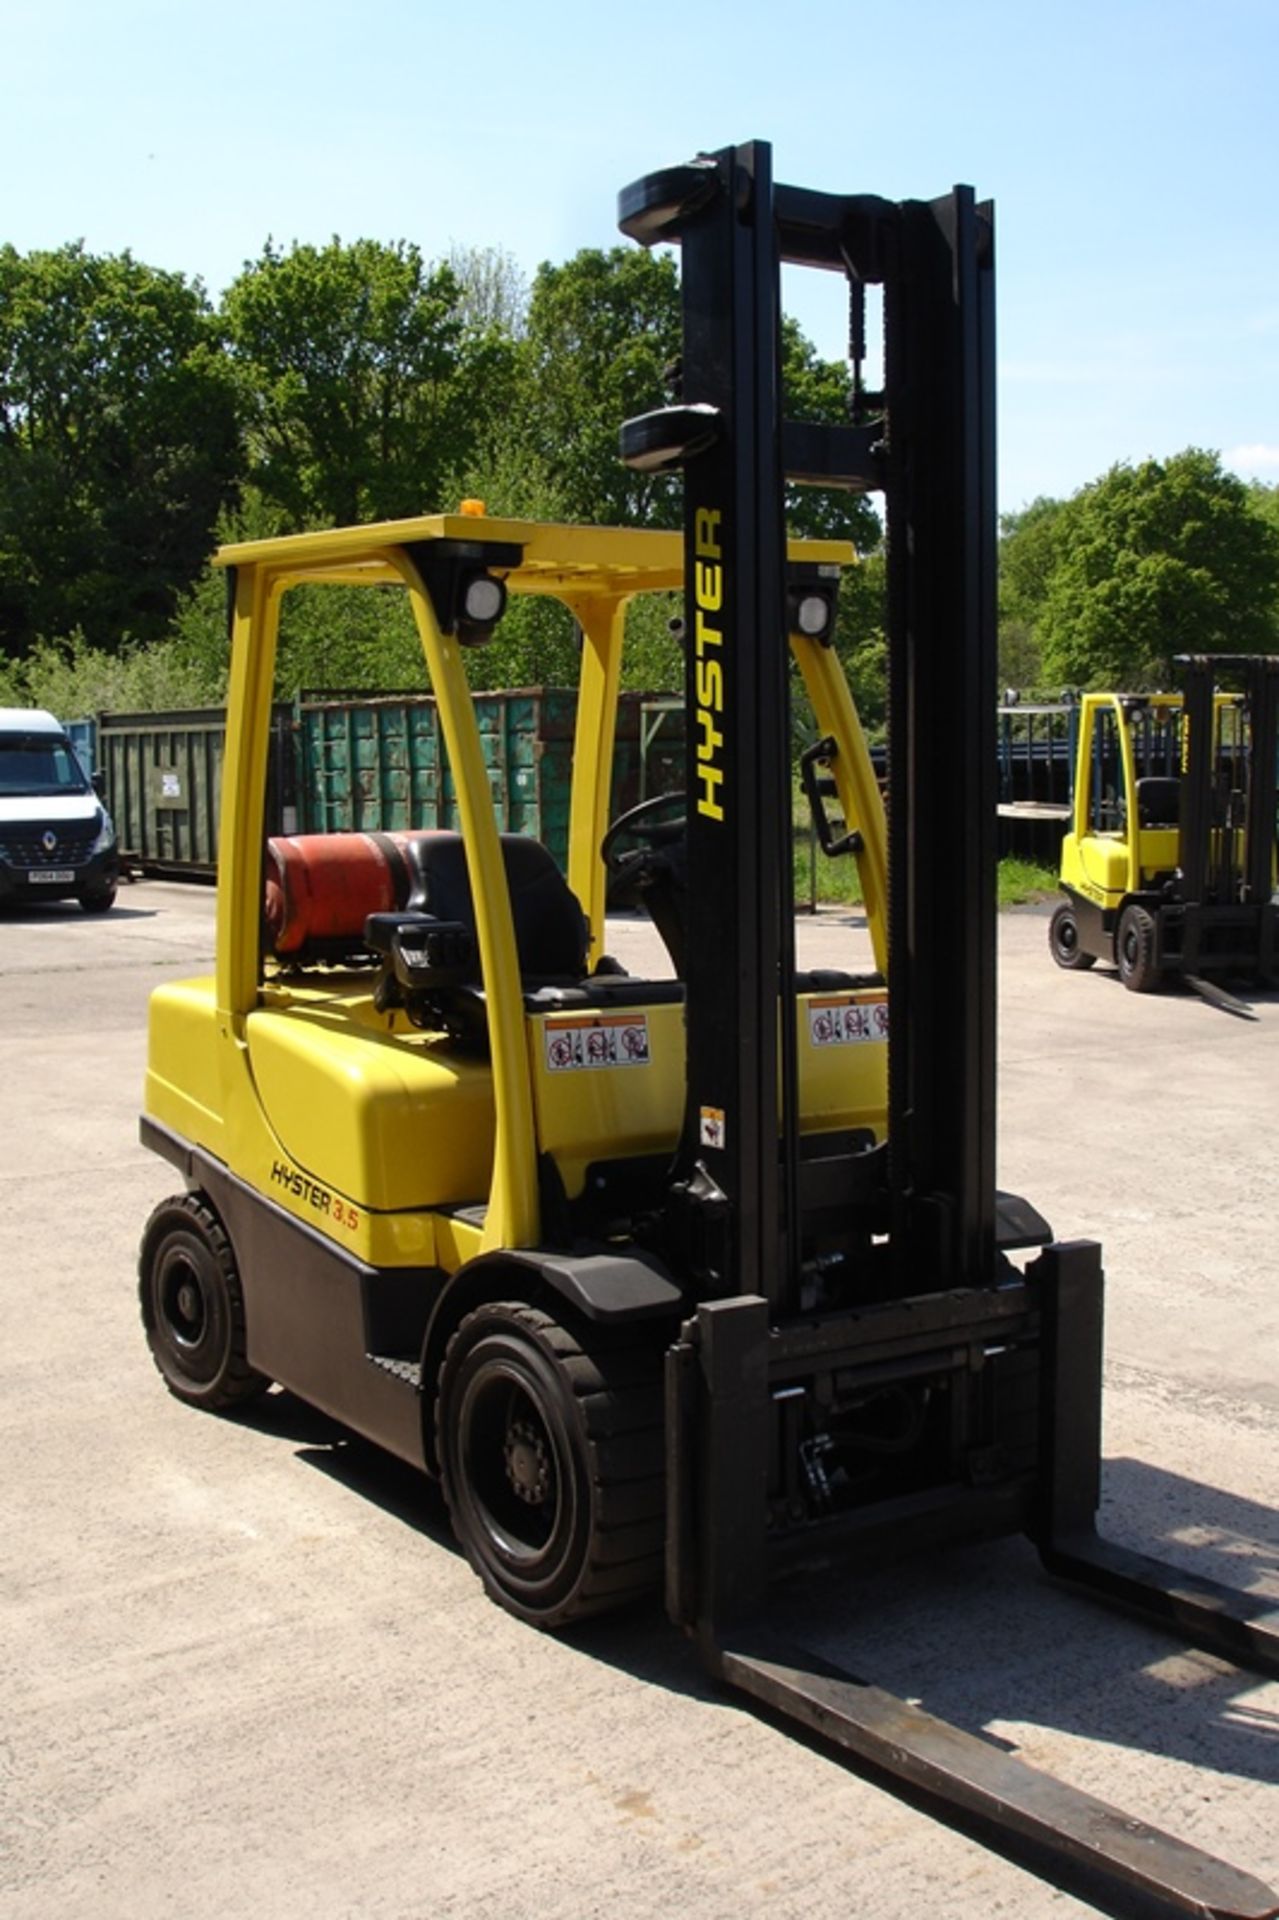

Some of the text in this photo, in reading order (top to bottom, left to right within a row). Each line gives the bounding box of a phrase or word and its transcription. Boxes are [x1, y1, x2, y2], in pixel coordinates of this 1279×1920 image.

[695, 507, 724, 822] HYSTER
[270, 1160, 359, 1231] HYSTER 3.5
